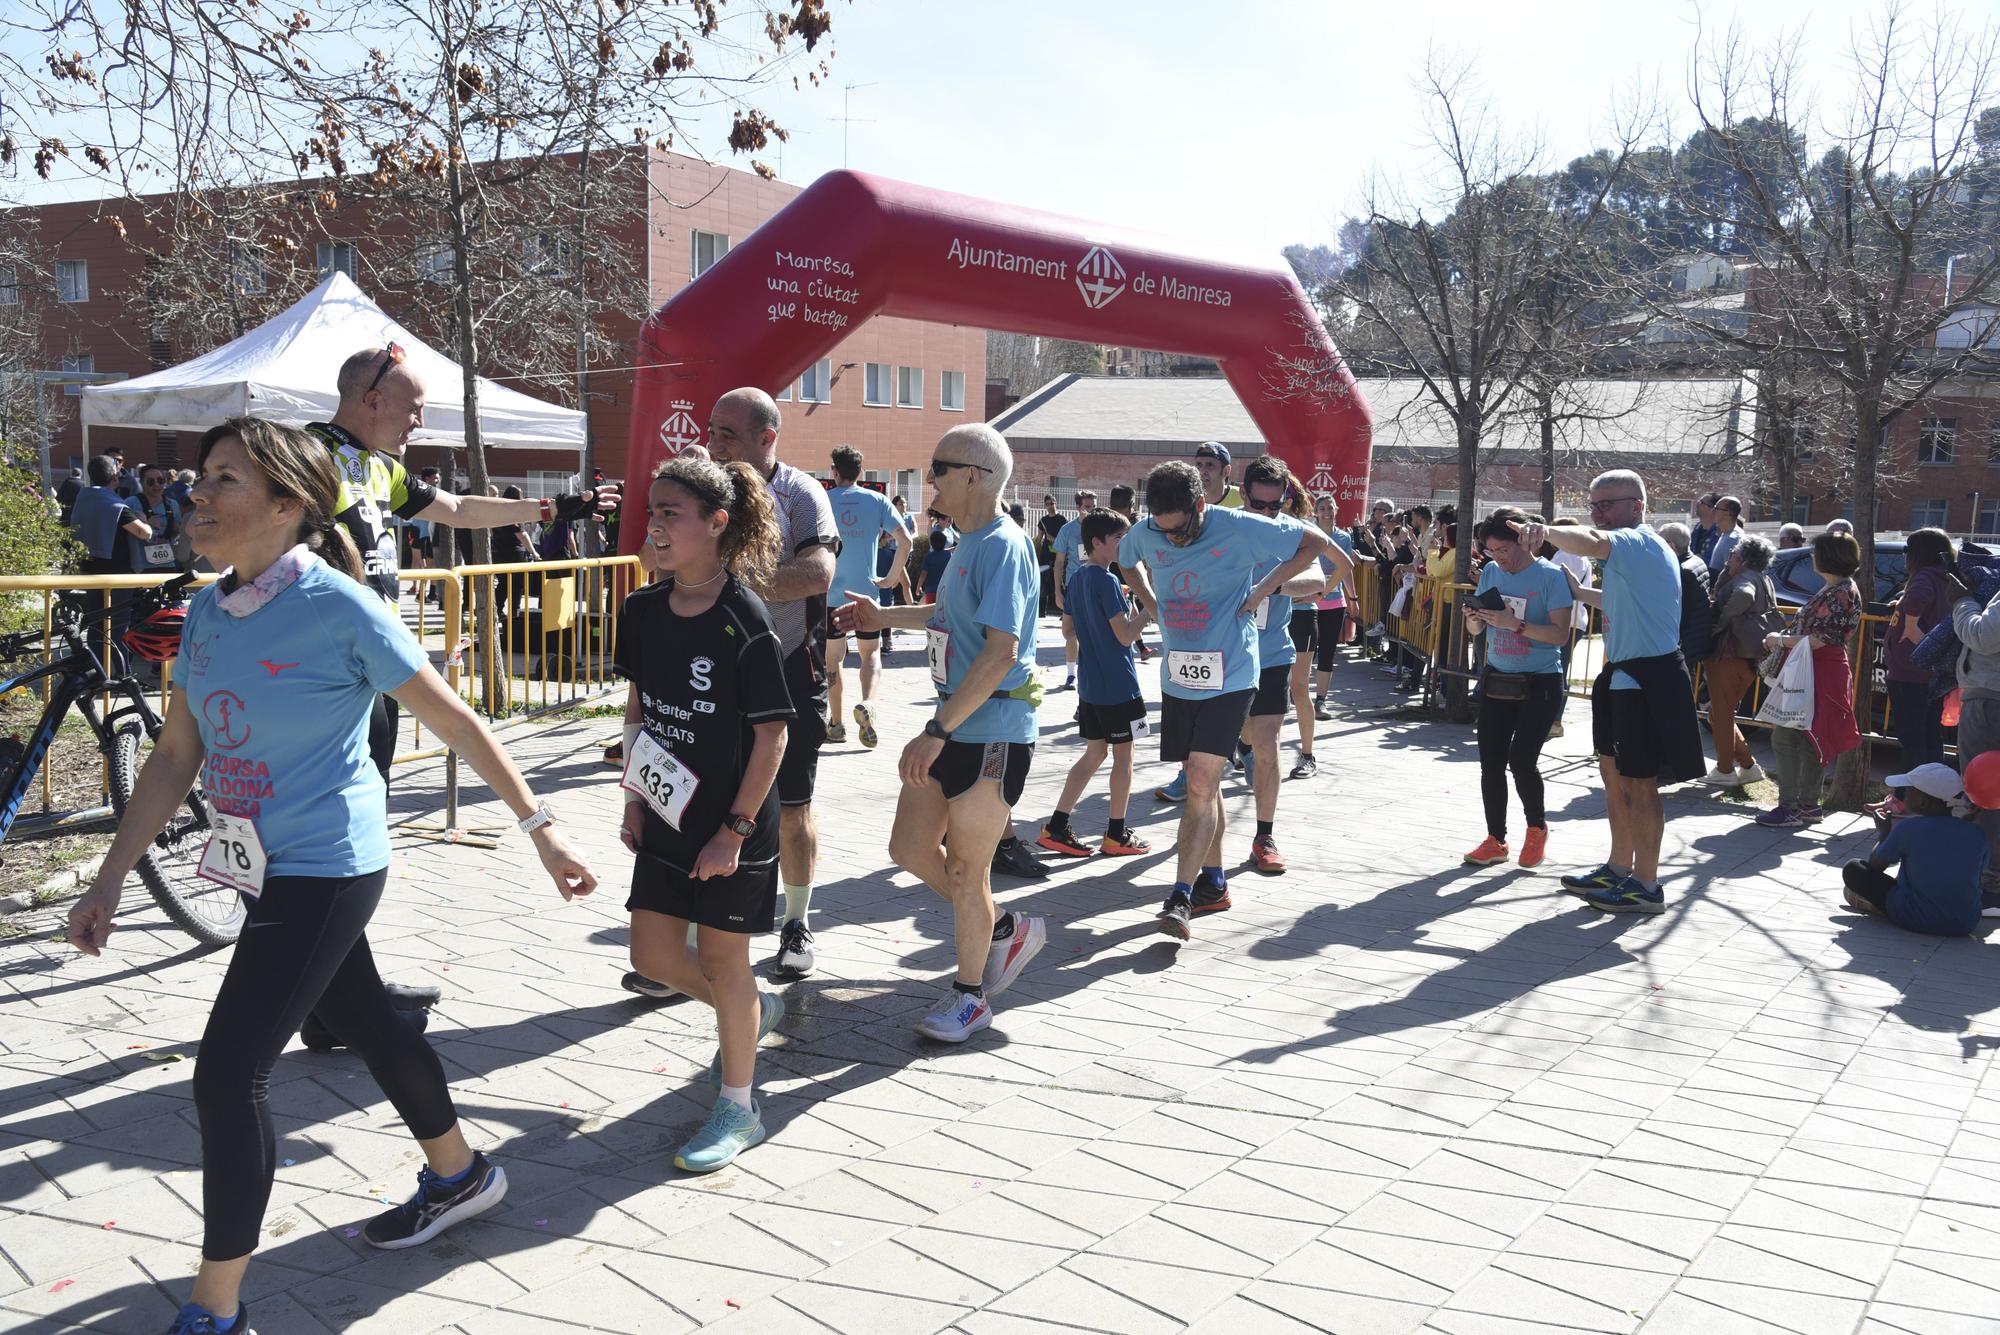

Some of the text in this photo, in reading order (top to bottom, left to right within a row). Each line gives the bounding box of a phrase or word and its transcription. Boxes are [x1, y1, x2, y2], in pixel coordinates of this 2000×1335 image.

[775, 250, 855, 279] Manresa,
[947, 237, 1232, 307] Ajuntament de Manresa
[767, 276, 860, 305] una ciutat
[767, 302, 848, 332] que batega
[152, 550, 169, 559] 460
[1179, 665, 1211, 680] 436
[210, 753, 270, 778] CURSA
[219, 777, 275, 799] DONA
[640, 763, 674, 807] 433
[219, 839, 251, 871] 78
